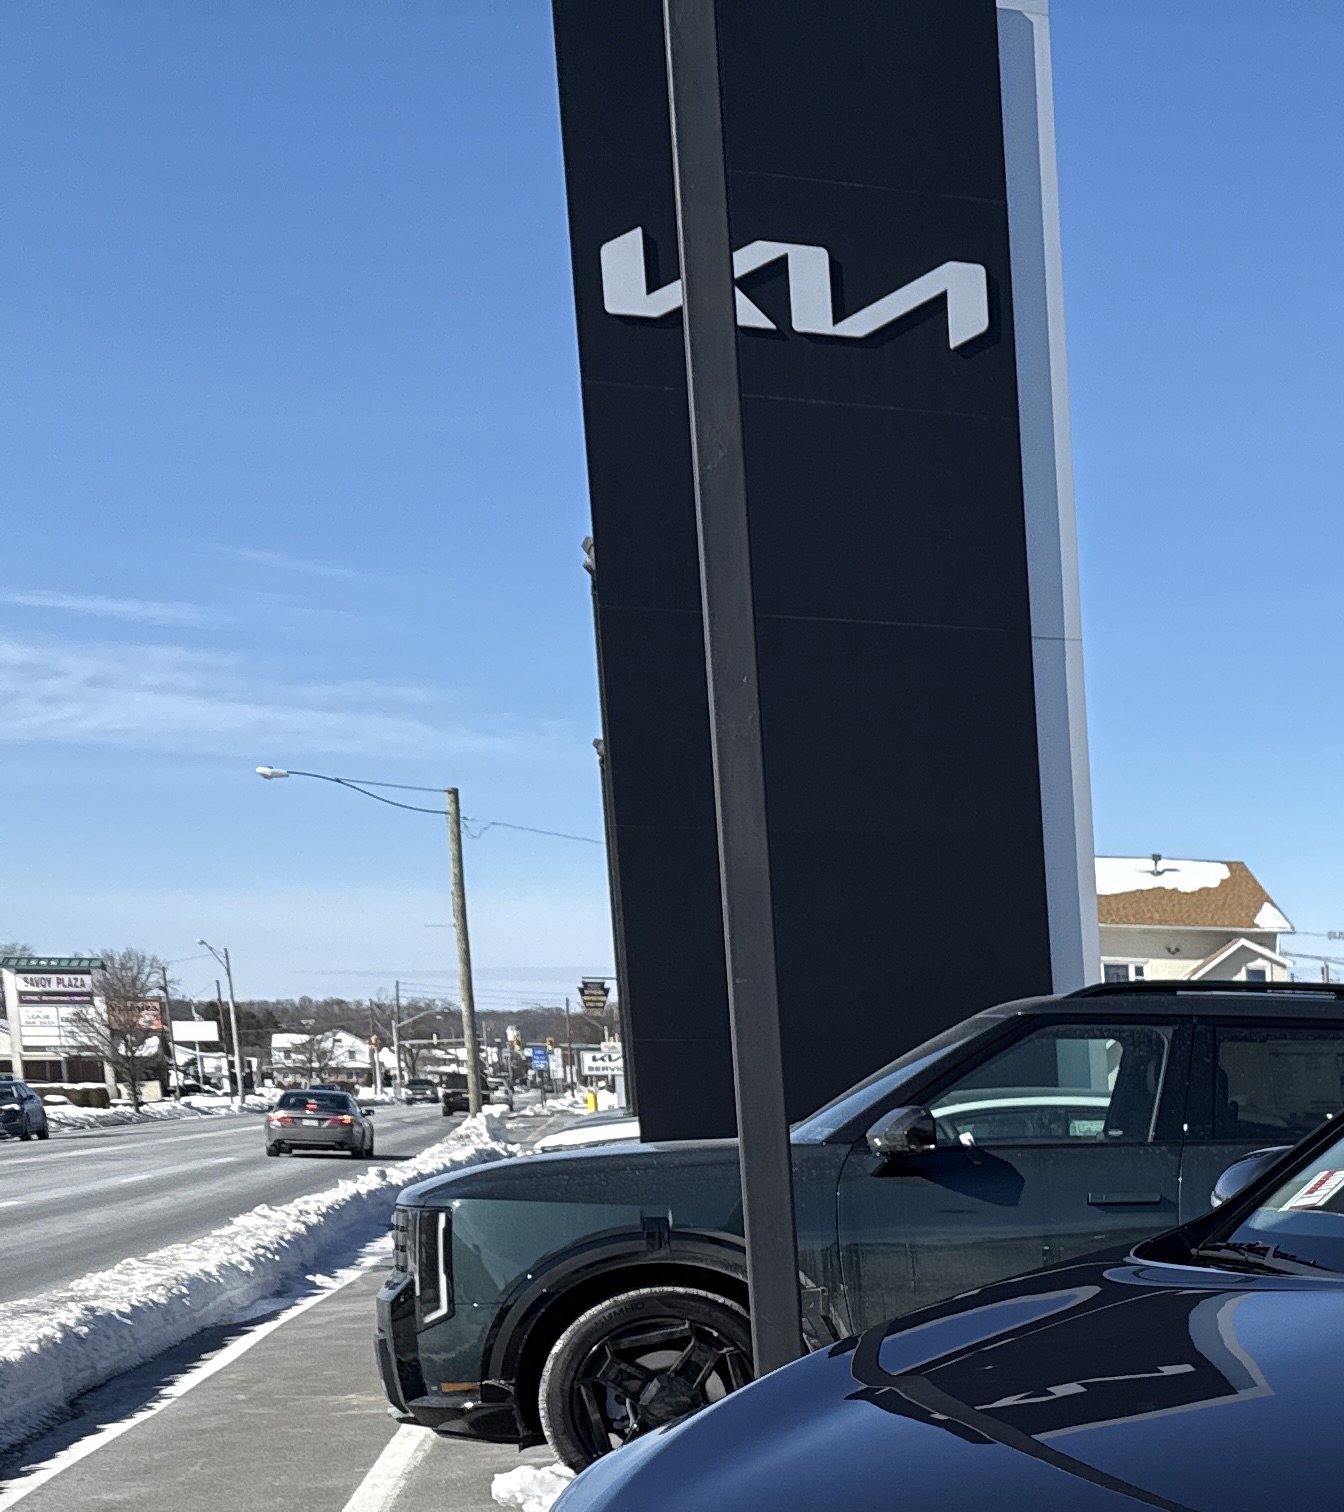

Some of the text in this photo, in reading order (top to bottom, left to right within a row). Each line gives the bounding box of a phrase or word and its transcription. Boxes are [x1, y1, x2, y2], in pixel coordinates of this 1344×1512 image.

[24, 976, 86, 989] SAVOY PLAZA
[594, 1302, 645, 1328] KUMHO
